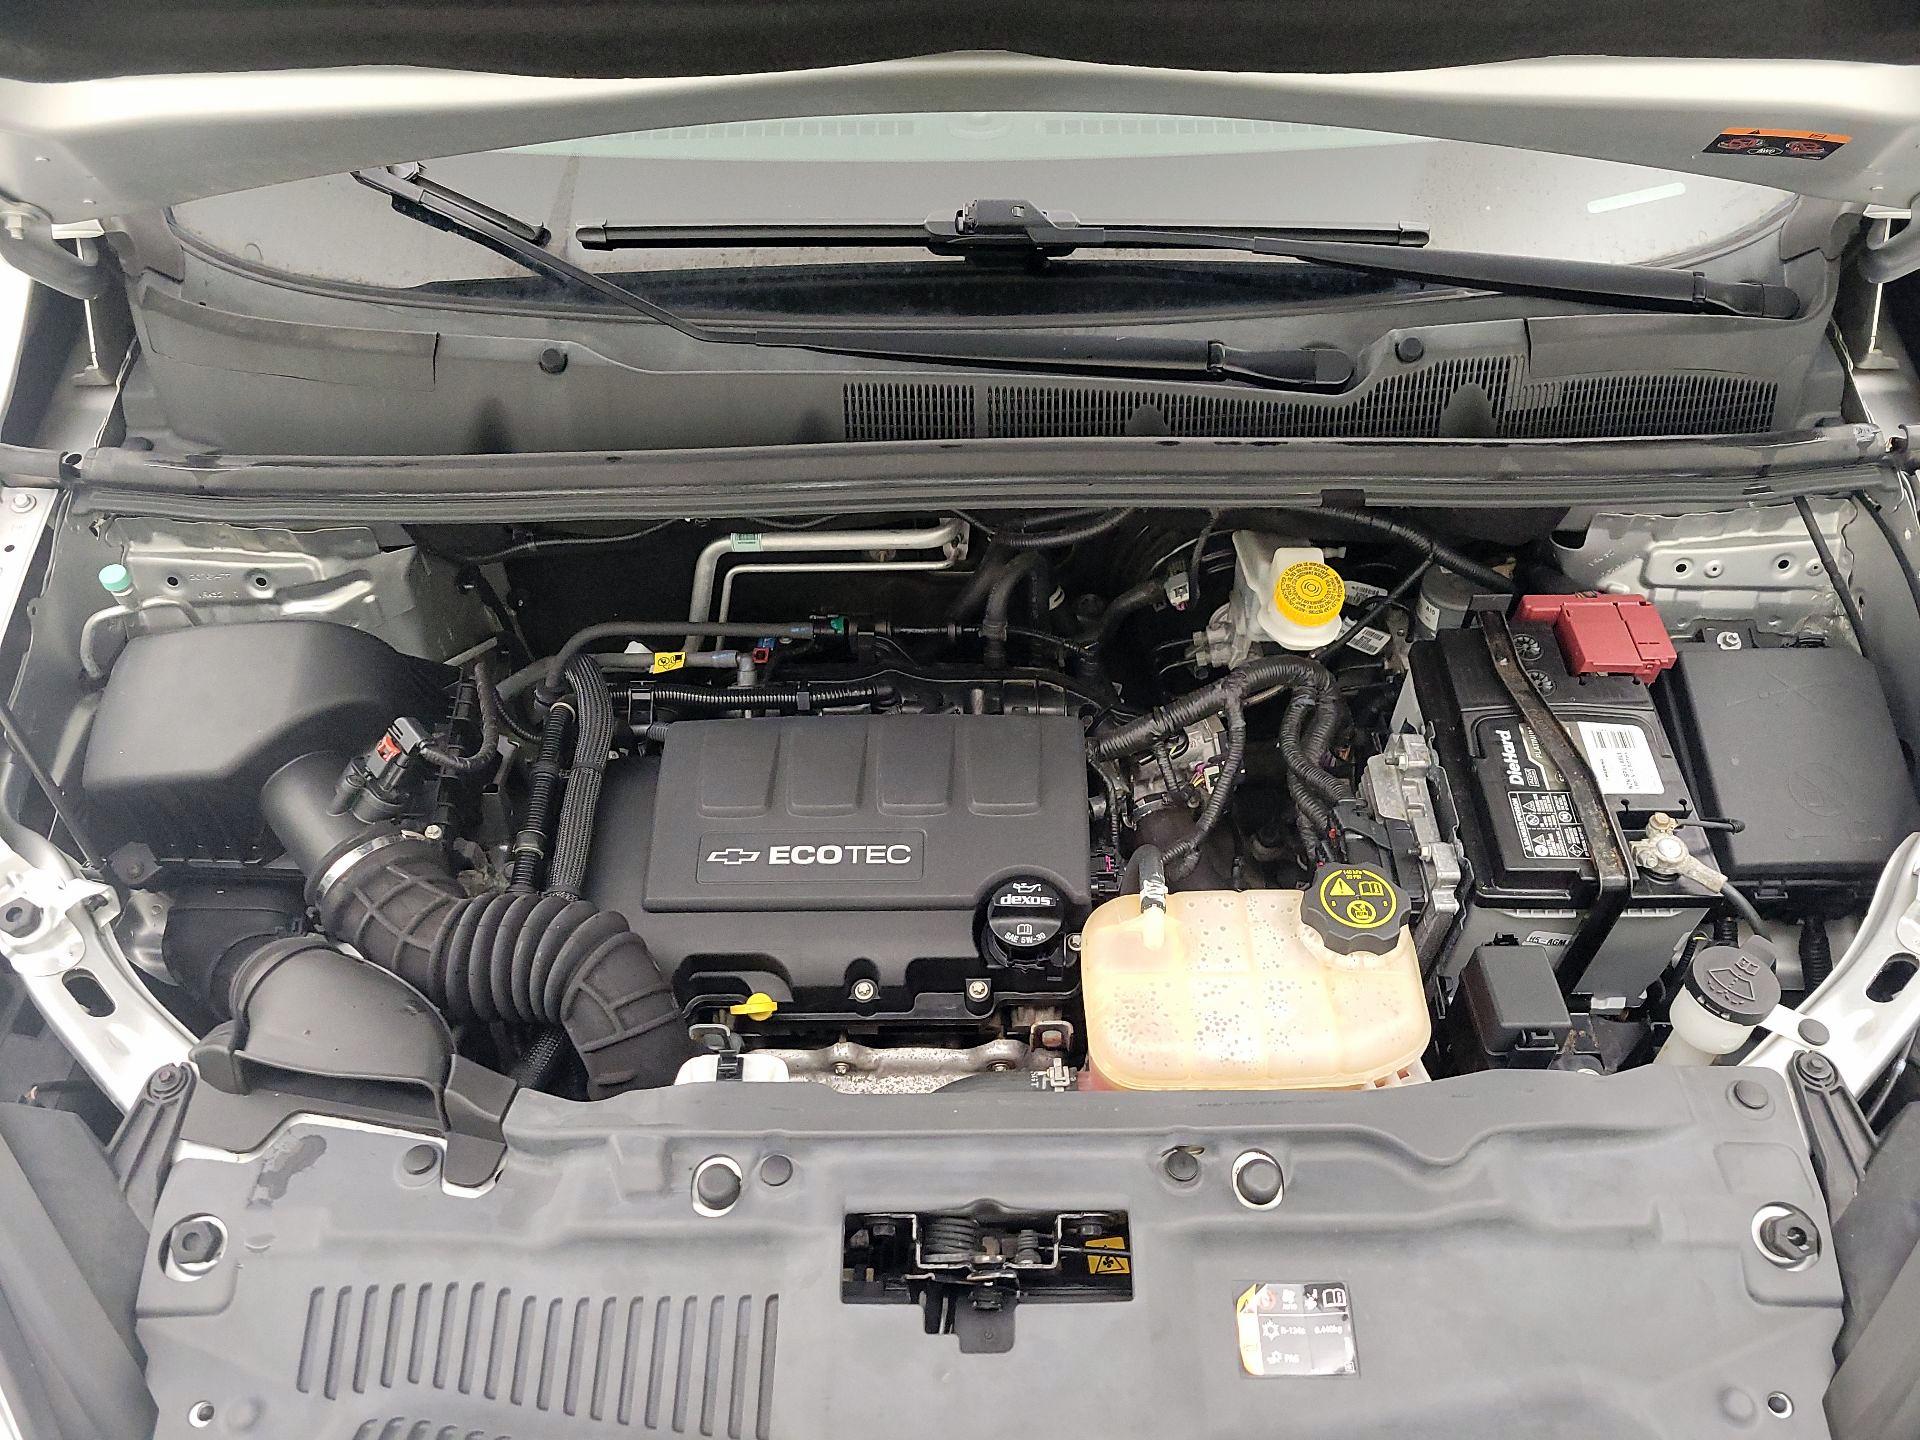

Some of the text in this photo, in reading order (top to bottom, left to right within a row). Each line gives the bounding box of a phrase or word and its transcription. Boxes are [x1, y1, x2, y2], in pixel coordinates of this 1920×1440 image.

[1495, 729, 1525, 786] DieHard
[768, 844, 912, 865] ECOTEC
[1000, 893, 1052, 906] dexos
[1004, 931, 1046, 944] SAE 5W-30
